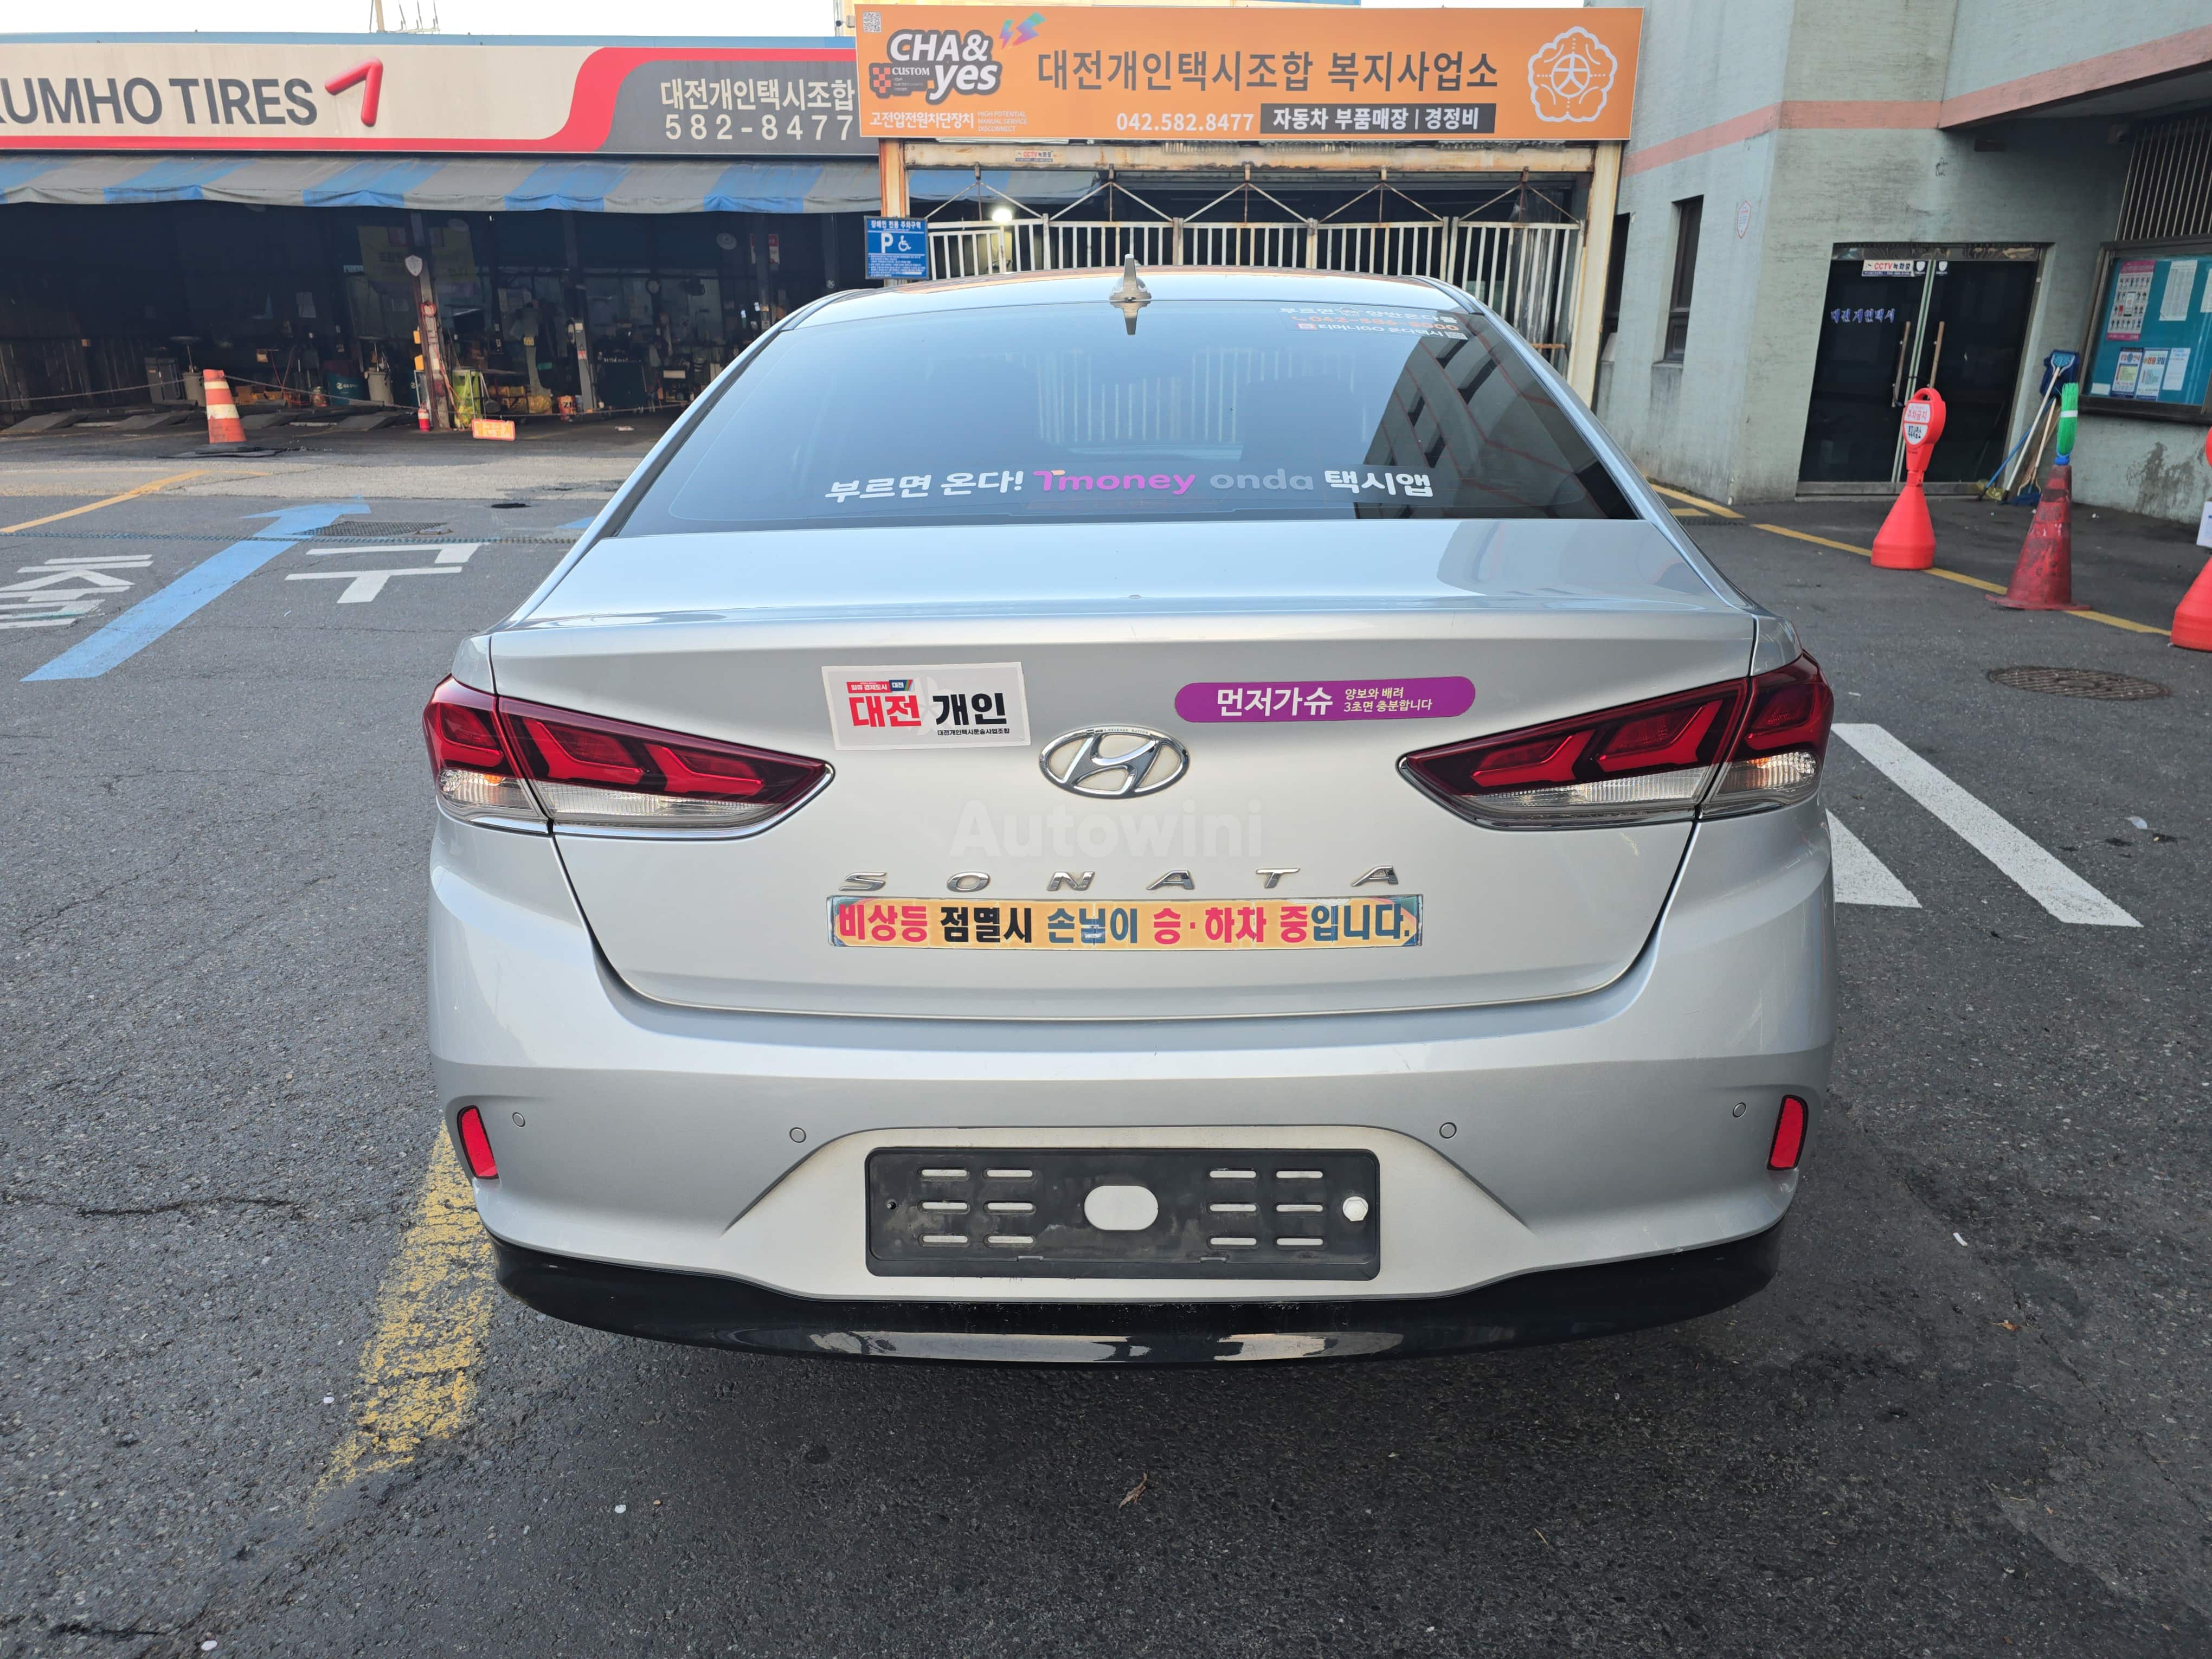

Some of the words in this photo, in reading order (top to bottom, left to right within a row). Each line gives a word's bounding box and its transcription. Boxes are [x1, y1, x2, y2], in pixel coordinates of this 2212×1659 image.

[890, 33, 988, 62] CHA&
[892, 67, 930, 76] CUSTOM
[929, 65, 998, 100] yes
[1038, 50, 1313, 91] 대전개인택시조합
[1328, 51, 1498, 92] 복지사업소
[0, 77, 162, 125] UMHO
[169, 78, 318, 125] TIRES
[660, 78, 855, 111] 대전개인택시조합
[665, 114, 854, 141] 582-8477
[870, 111, 975, 128] 고전압전원차단장치
[1116, 112, 1254, 132] 042.582.8477
[1272, 108, 1328, 130] 자동차
[1334, 108, 1409, 130] 부품매장
[1424, 107, 1479, 130] 경정비
[881, 233, 893, 253] P
[825, 474, 932, 503] 부르면
[941, 470, 1024, 496] 온다!
[1033, 470, 1196, 495] Tmoney
[1210, 468, 1314, 491] onda
[1324, 470, 1434, 497] 택시앱
[1217, 687, 1333, 717] 먼저가슈
[1343, 701, 1374, 713] 3초면
[1377, 699, 1433, 712] 충분합니다
[1345, 687, 1379, 700] 양보와
[1381, 687, 1404, 699] 배려
[848, 695, 922, 728] 대전
[933, 692, 1007, 725] 개인
[839, 865, 1399, 892] SONATA
[838, 903, 928, 943] 비상등
[940, 906, 1032, 943] 점멸시
[1047, 907, 1138, 944] 손님이
